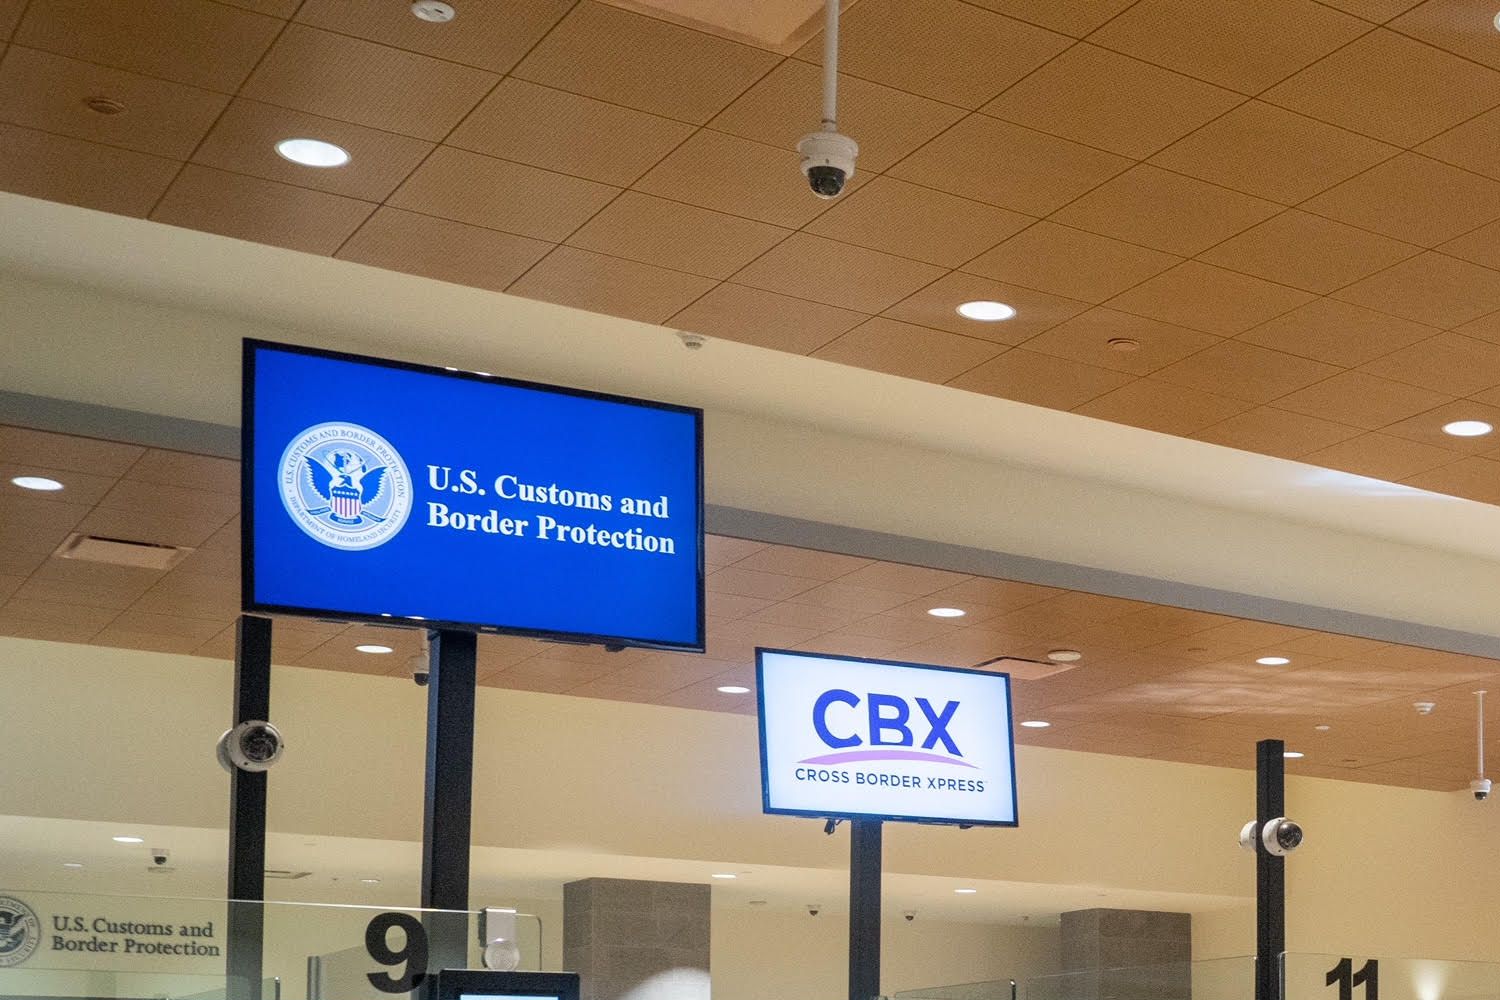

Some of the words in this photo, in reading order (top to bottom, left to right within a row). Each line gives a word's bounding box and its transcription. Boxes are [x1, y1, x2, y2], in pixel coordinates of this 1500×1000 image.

[427, 465, 486, 496] U.S.
[494, 474, 612, 511] Customs
[620, 496, 670, 518] and
[427, 502, 529, 537] Border
[536, 515, 676, 554] Protection
[812, 688, 964, 758] CBX
[795, 768, 850, 784] CROSS
[856, 772, 922, 788] BORDER
[927, 777, 985, 793] XPRESS
[51, 936, 119, 953] Border
[124, 938, 220, 957] Protection
[52, 915, 89, 933] U.S.
[93, 918, 173, 937] Customs
[179, 921, 213, 938] and
[365, 912, 429, 994] 9
